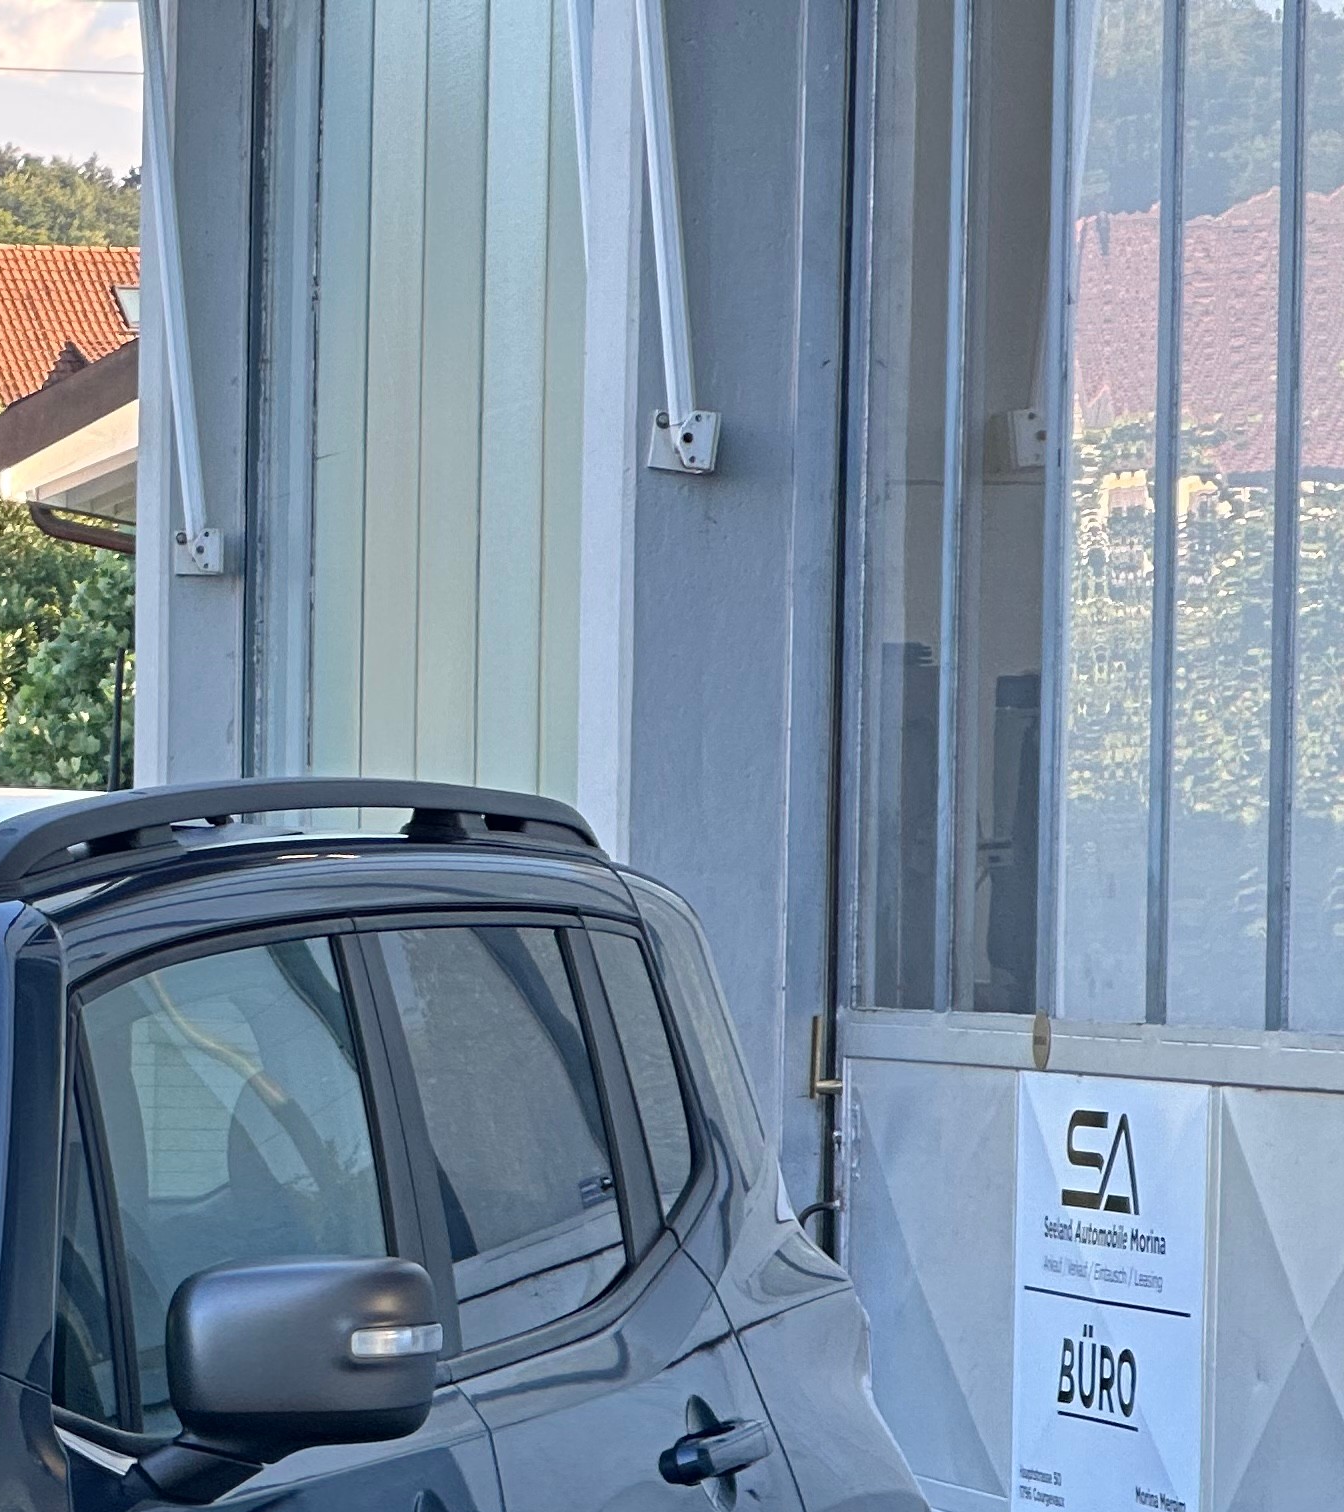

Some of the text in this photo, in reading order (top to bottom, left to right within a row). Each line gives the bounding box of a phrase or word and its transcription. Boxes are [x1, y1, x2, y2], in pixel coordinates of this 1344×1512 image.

[1044, 1215, 1166, 1255] Seeland Automobile Morina
[1057, 1323, 1137, 1418] BÜRO
